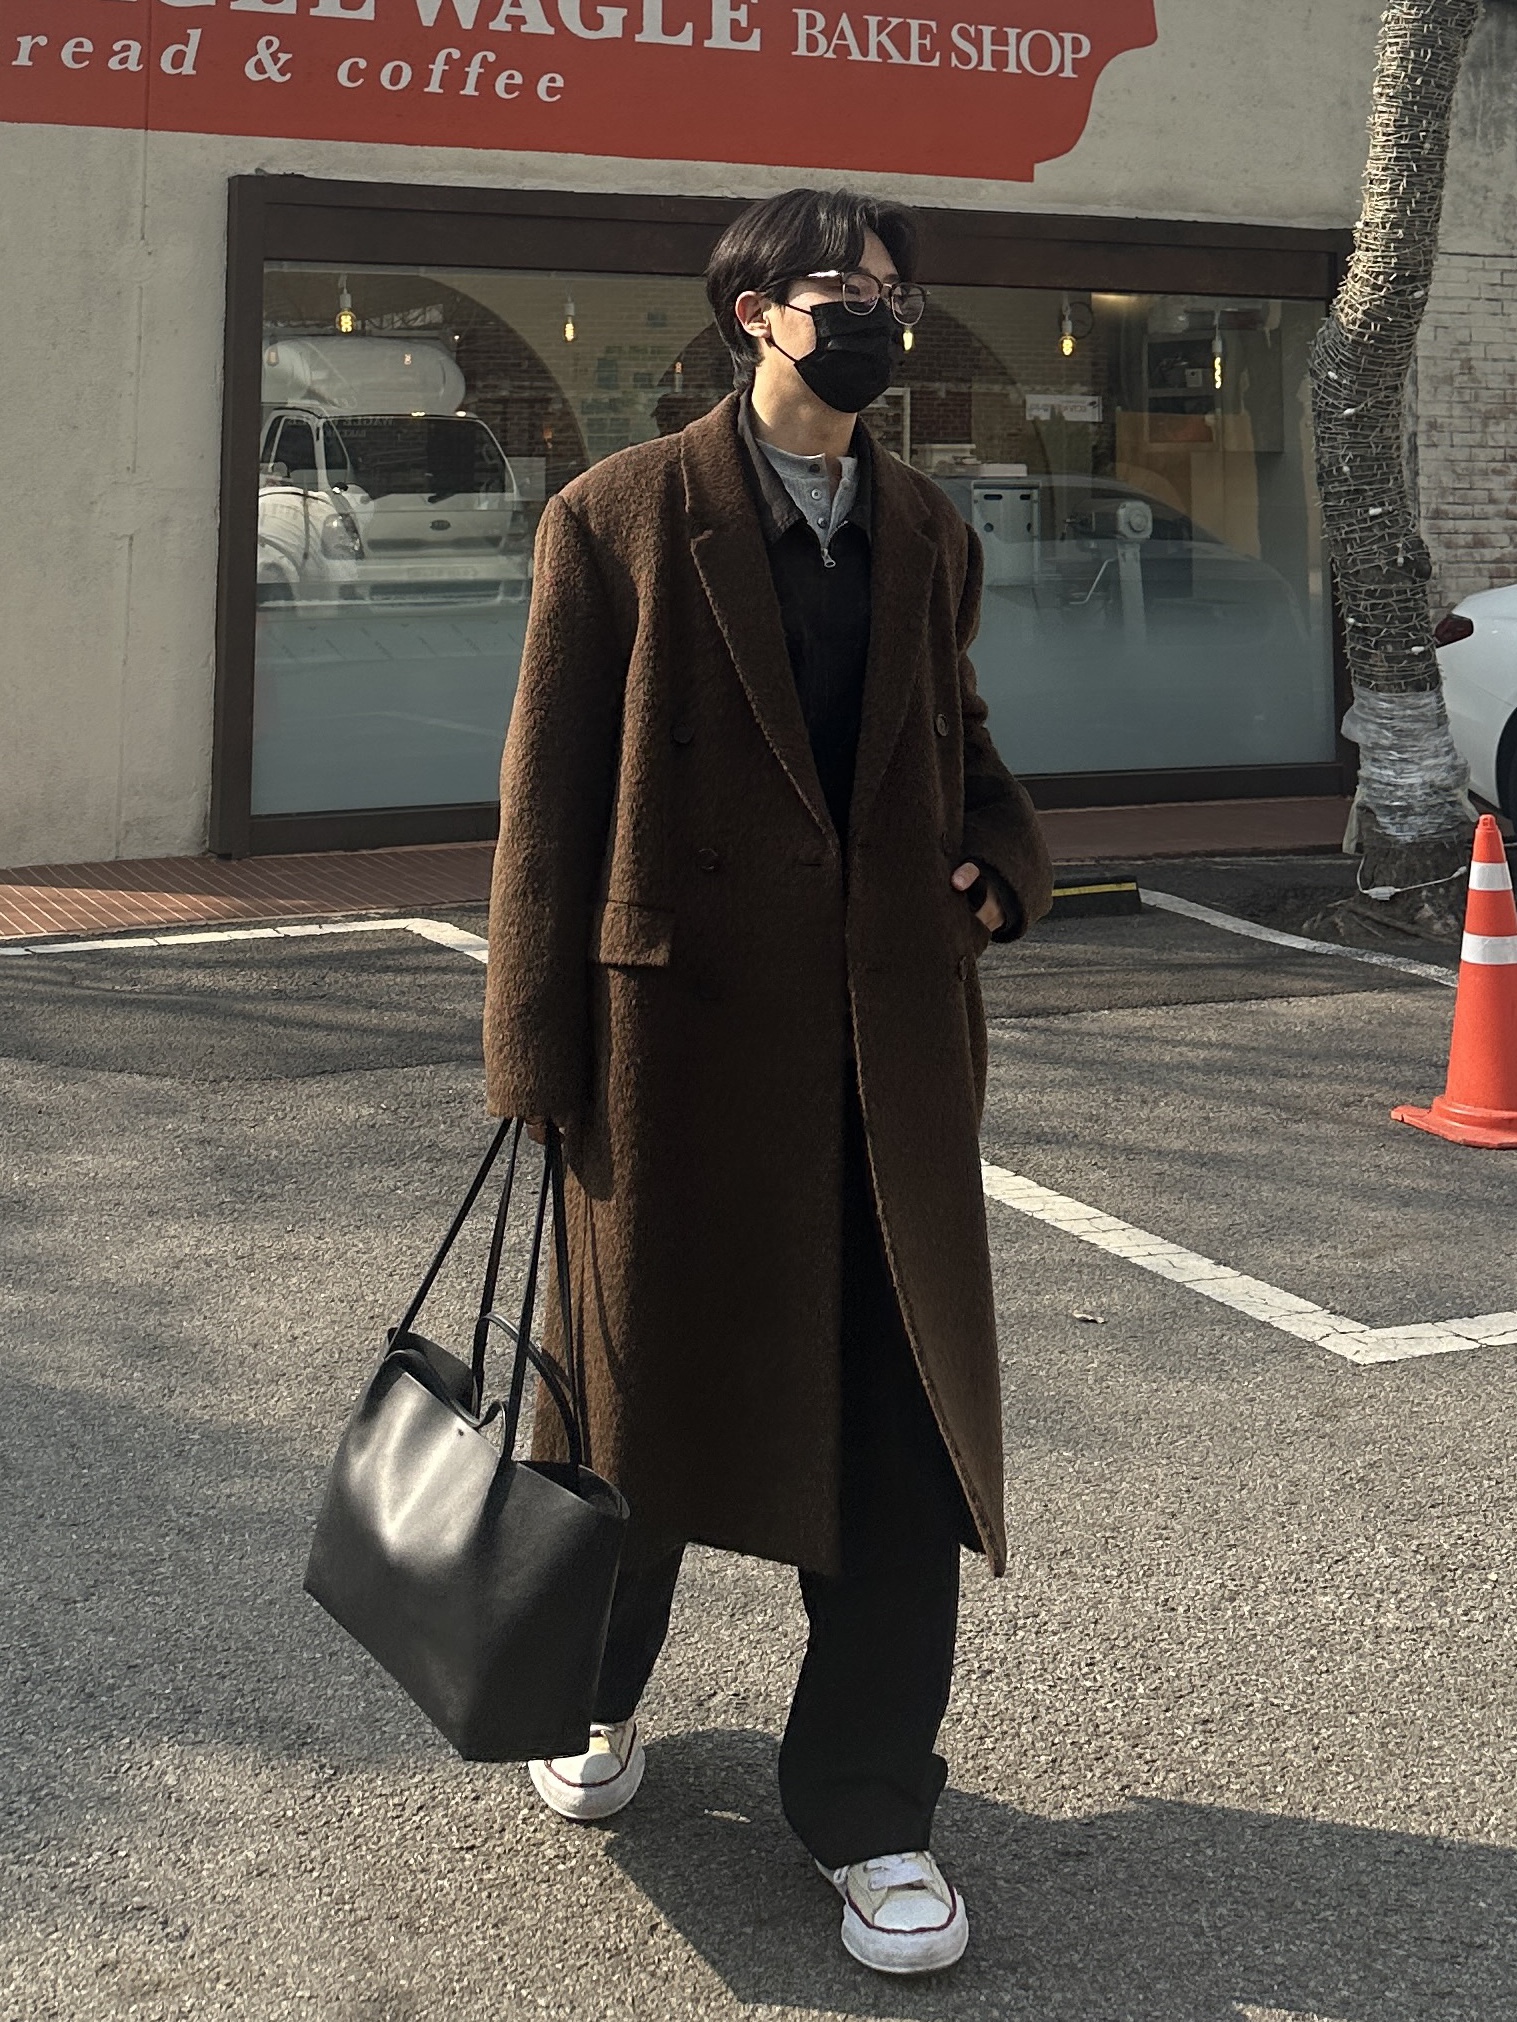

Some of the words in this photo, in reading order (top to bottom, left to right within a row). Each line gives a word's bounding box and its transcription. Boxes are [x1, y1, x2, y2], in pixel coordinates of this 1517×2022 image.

[11, 29, 203, 76] read
[243, 35, 293, 83] &
[336, 47, 565, 103] coffee
[791, 8, 941, 67] BAKE
[950, 22, 1092, 79] SHOP
